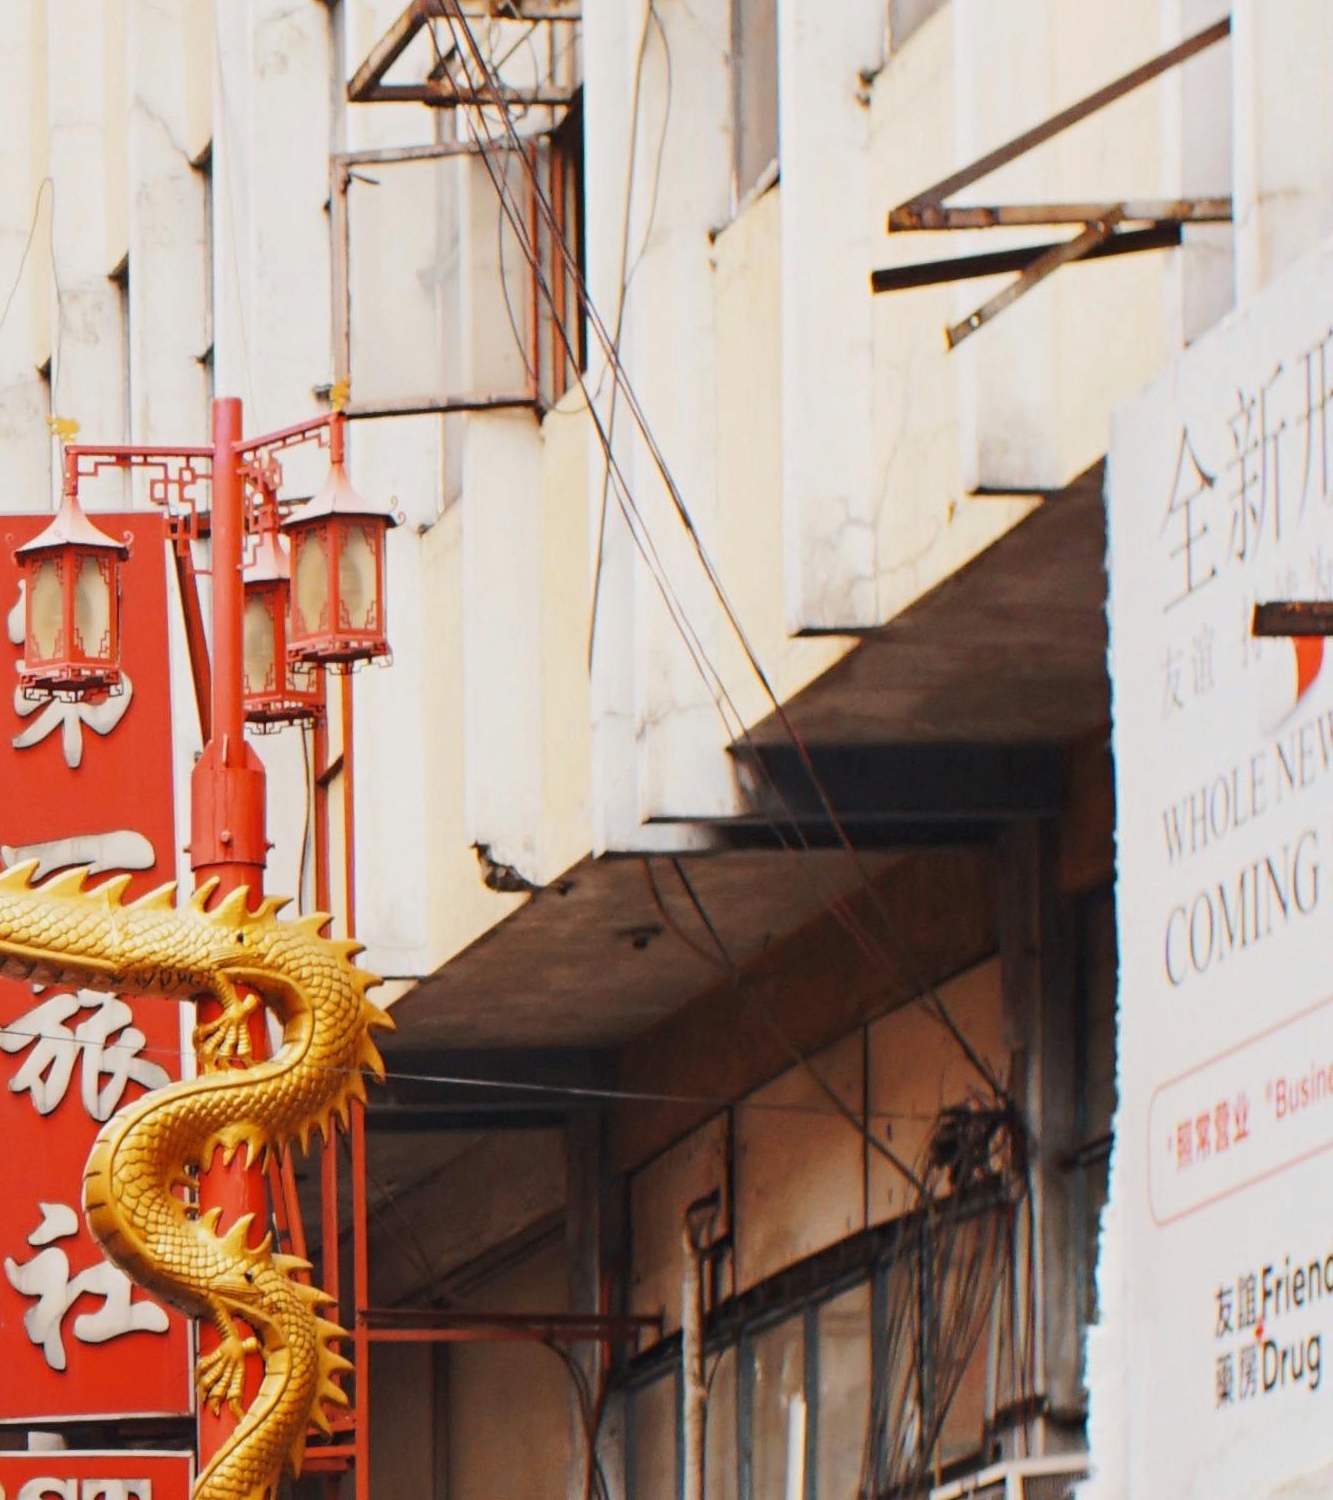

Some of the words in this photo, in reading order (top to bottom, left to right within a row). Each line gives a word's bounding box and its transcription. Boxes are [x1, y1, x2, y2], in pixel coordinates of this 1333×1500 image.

[1161, 749, 1267, 866] WHOLE
[1164, 828, 1319, 988] COMING
[1260, 1331, 1323, 1393] Drug
